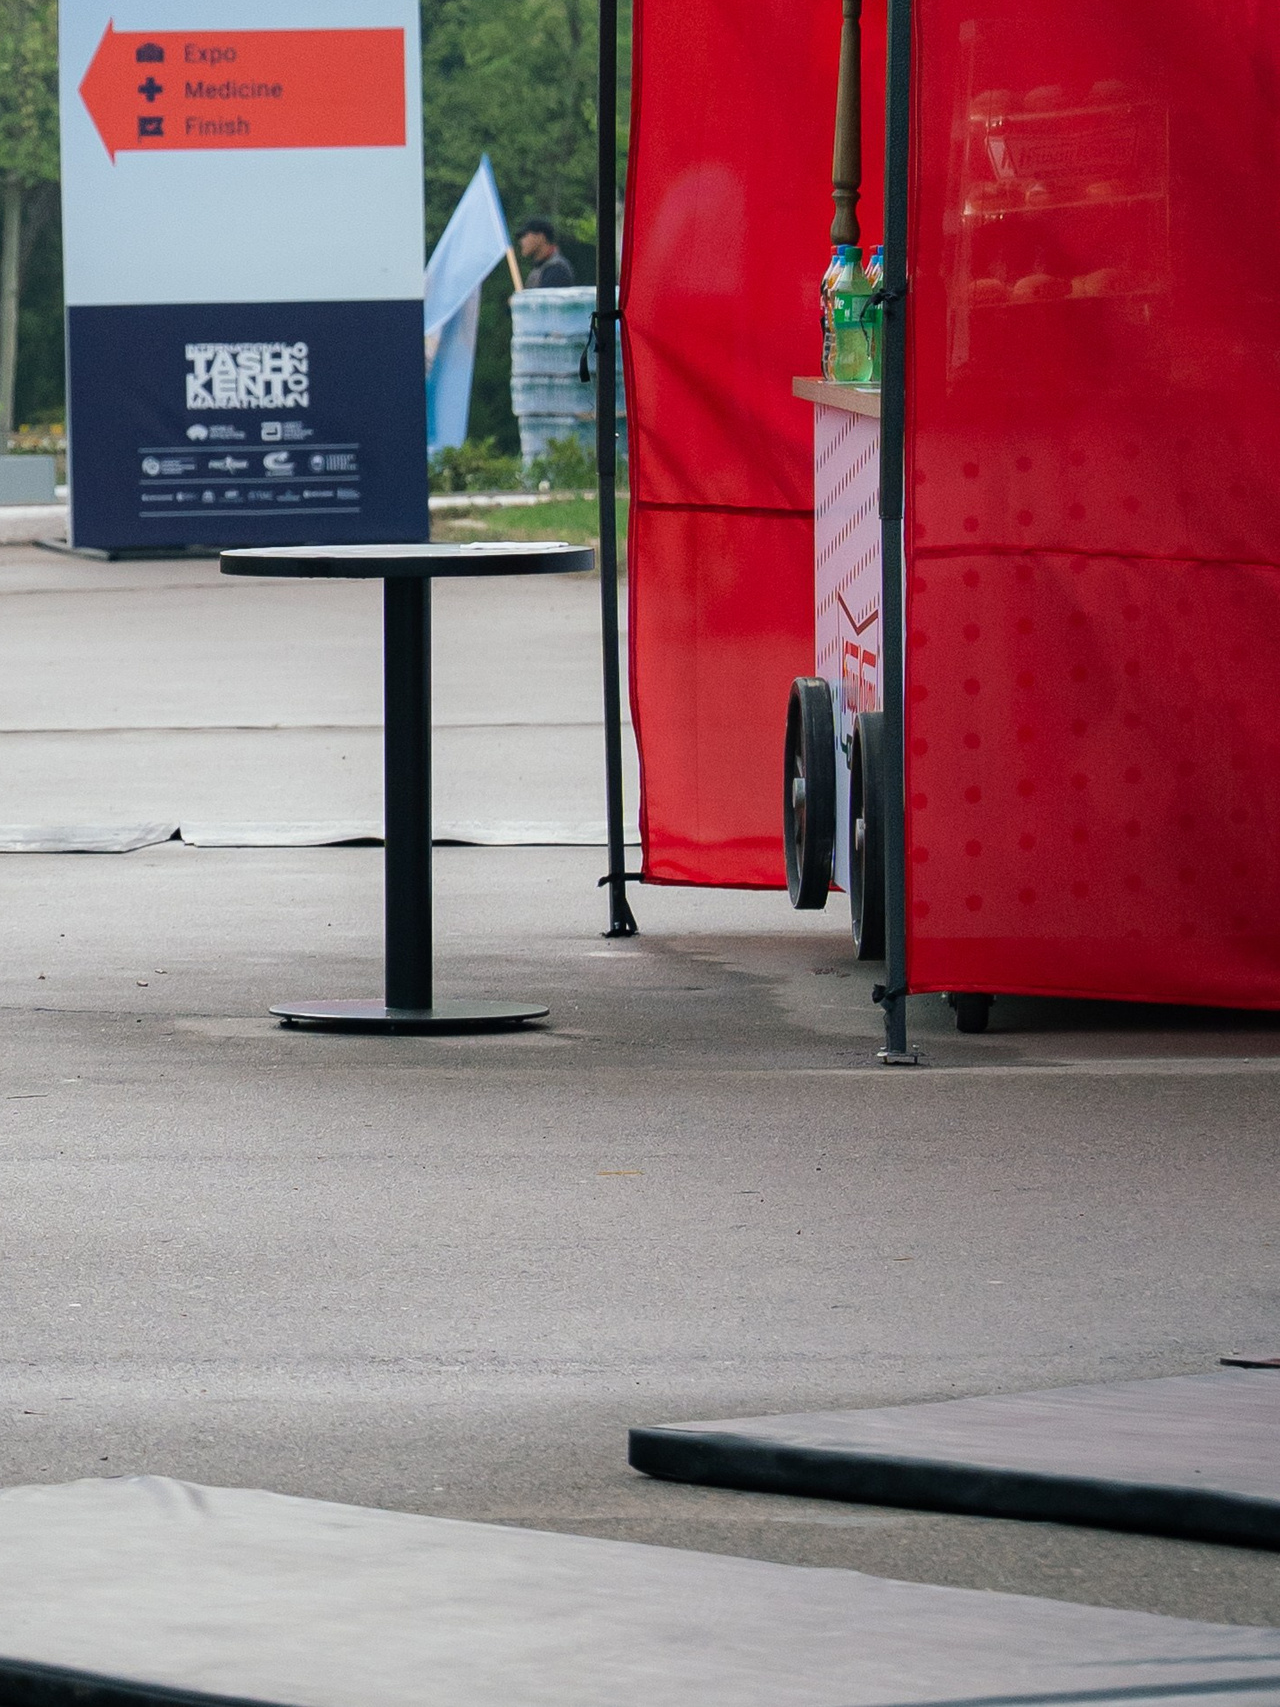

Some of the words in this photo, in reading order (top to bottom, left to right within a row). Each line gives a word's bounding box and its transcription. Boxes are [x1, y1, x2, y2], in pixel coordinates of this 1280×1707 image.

[184, 43, 237, 68] Expo
[184, 80, 283, 100] Medicine
[185, 116, 250, 137] Finish
[185, 349, 291, 378] TASH
[186, 372, 286, 399] KENT
